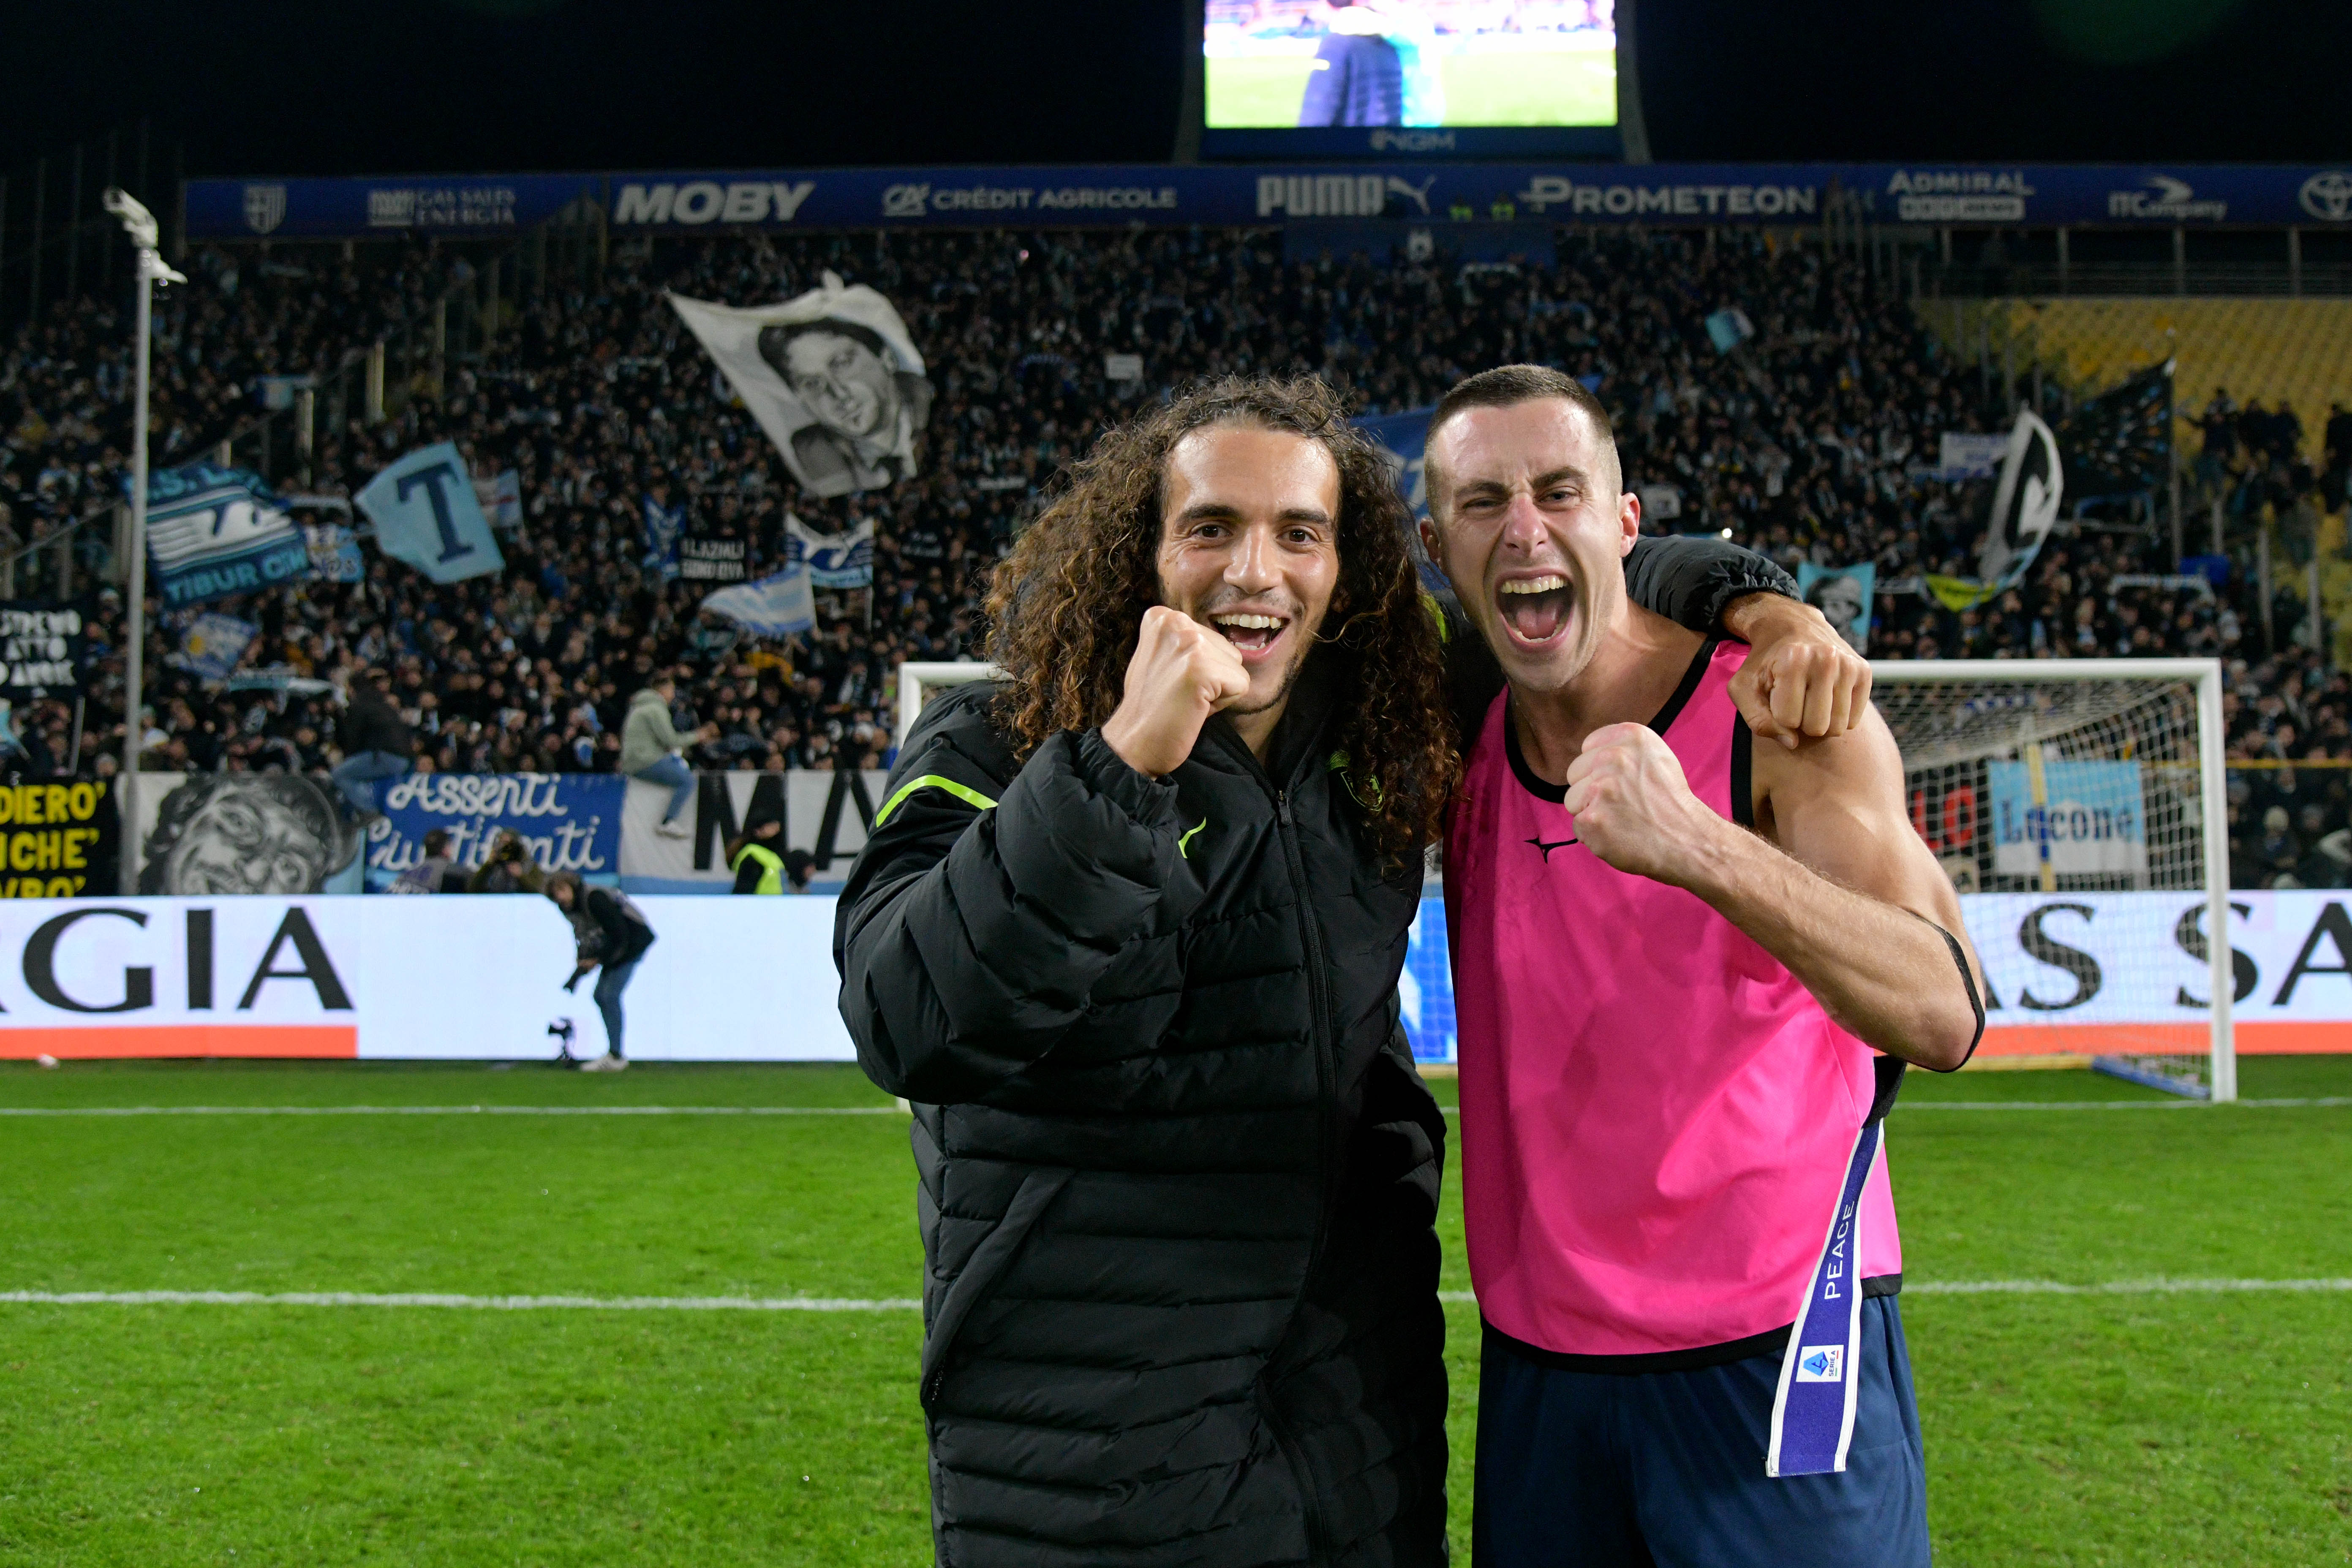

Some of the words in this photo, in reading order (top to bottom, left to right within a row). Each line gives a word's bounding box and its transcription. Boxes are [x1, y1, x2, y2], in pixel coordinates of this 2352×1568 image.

[613, 180, 817, 225] MOBY
[931, 185, 1035, 210] CRÉDIT
[1038, 187, 1178, 210] AGRICOLE
[1256, 174, 1386, 217] PUMA
[1519, 175, 1817, 215] PROMETEON
[1886, 169, 2036, 196] ADMIRAL
[396, 462, 474, 565] T
[165, 561, 261, 602] TIBUR
[386, 771, 568, 817] Assenti
[0, 906, 355, 1013] GIA
[1824, 1200, 1855, 1300] PEACE
